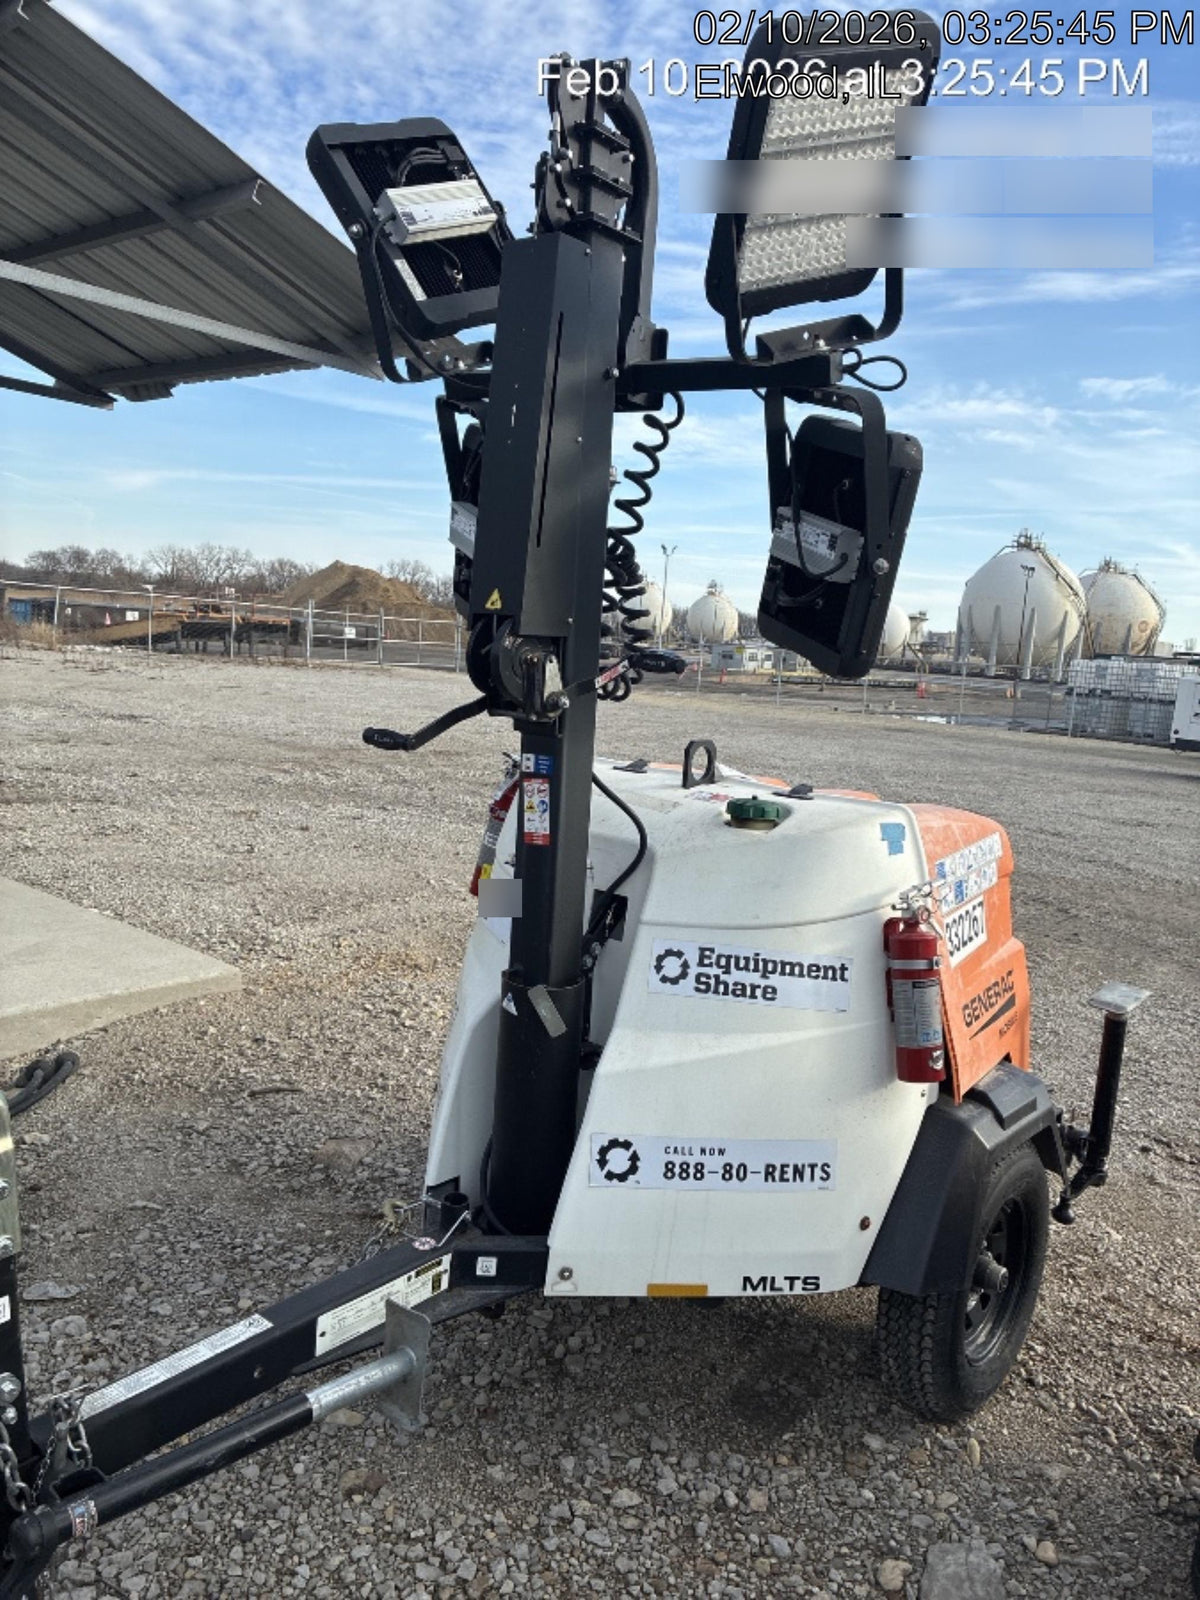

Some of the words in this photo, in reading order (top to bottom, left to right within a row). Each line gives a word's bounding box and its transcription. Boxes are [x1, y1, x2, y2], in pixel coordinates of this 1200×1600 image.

[696, 946, 849, 983] Equipment
[694, 972, 778, 1002] Share
[962, 968, 1015, 1028] GENERAC
[664, 1145, 695, 1157] CALL
[699, 1146, 727, 1157] NOW
[662, 1160, 832, 1184] 888-80-RENTS
[741, 1276, 821, 1292] MLTS
